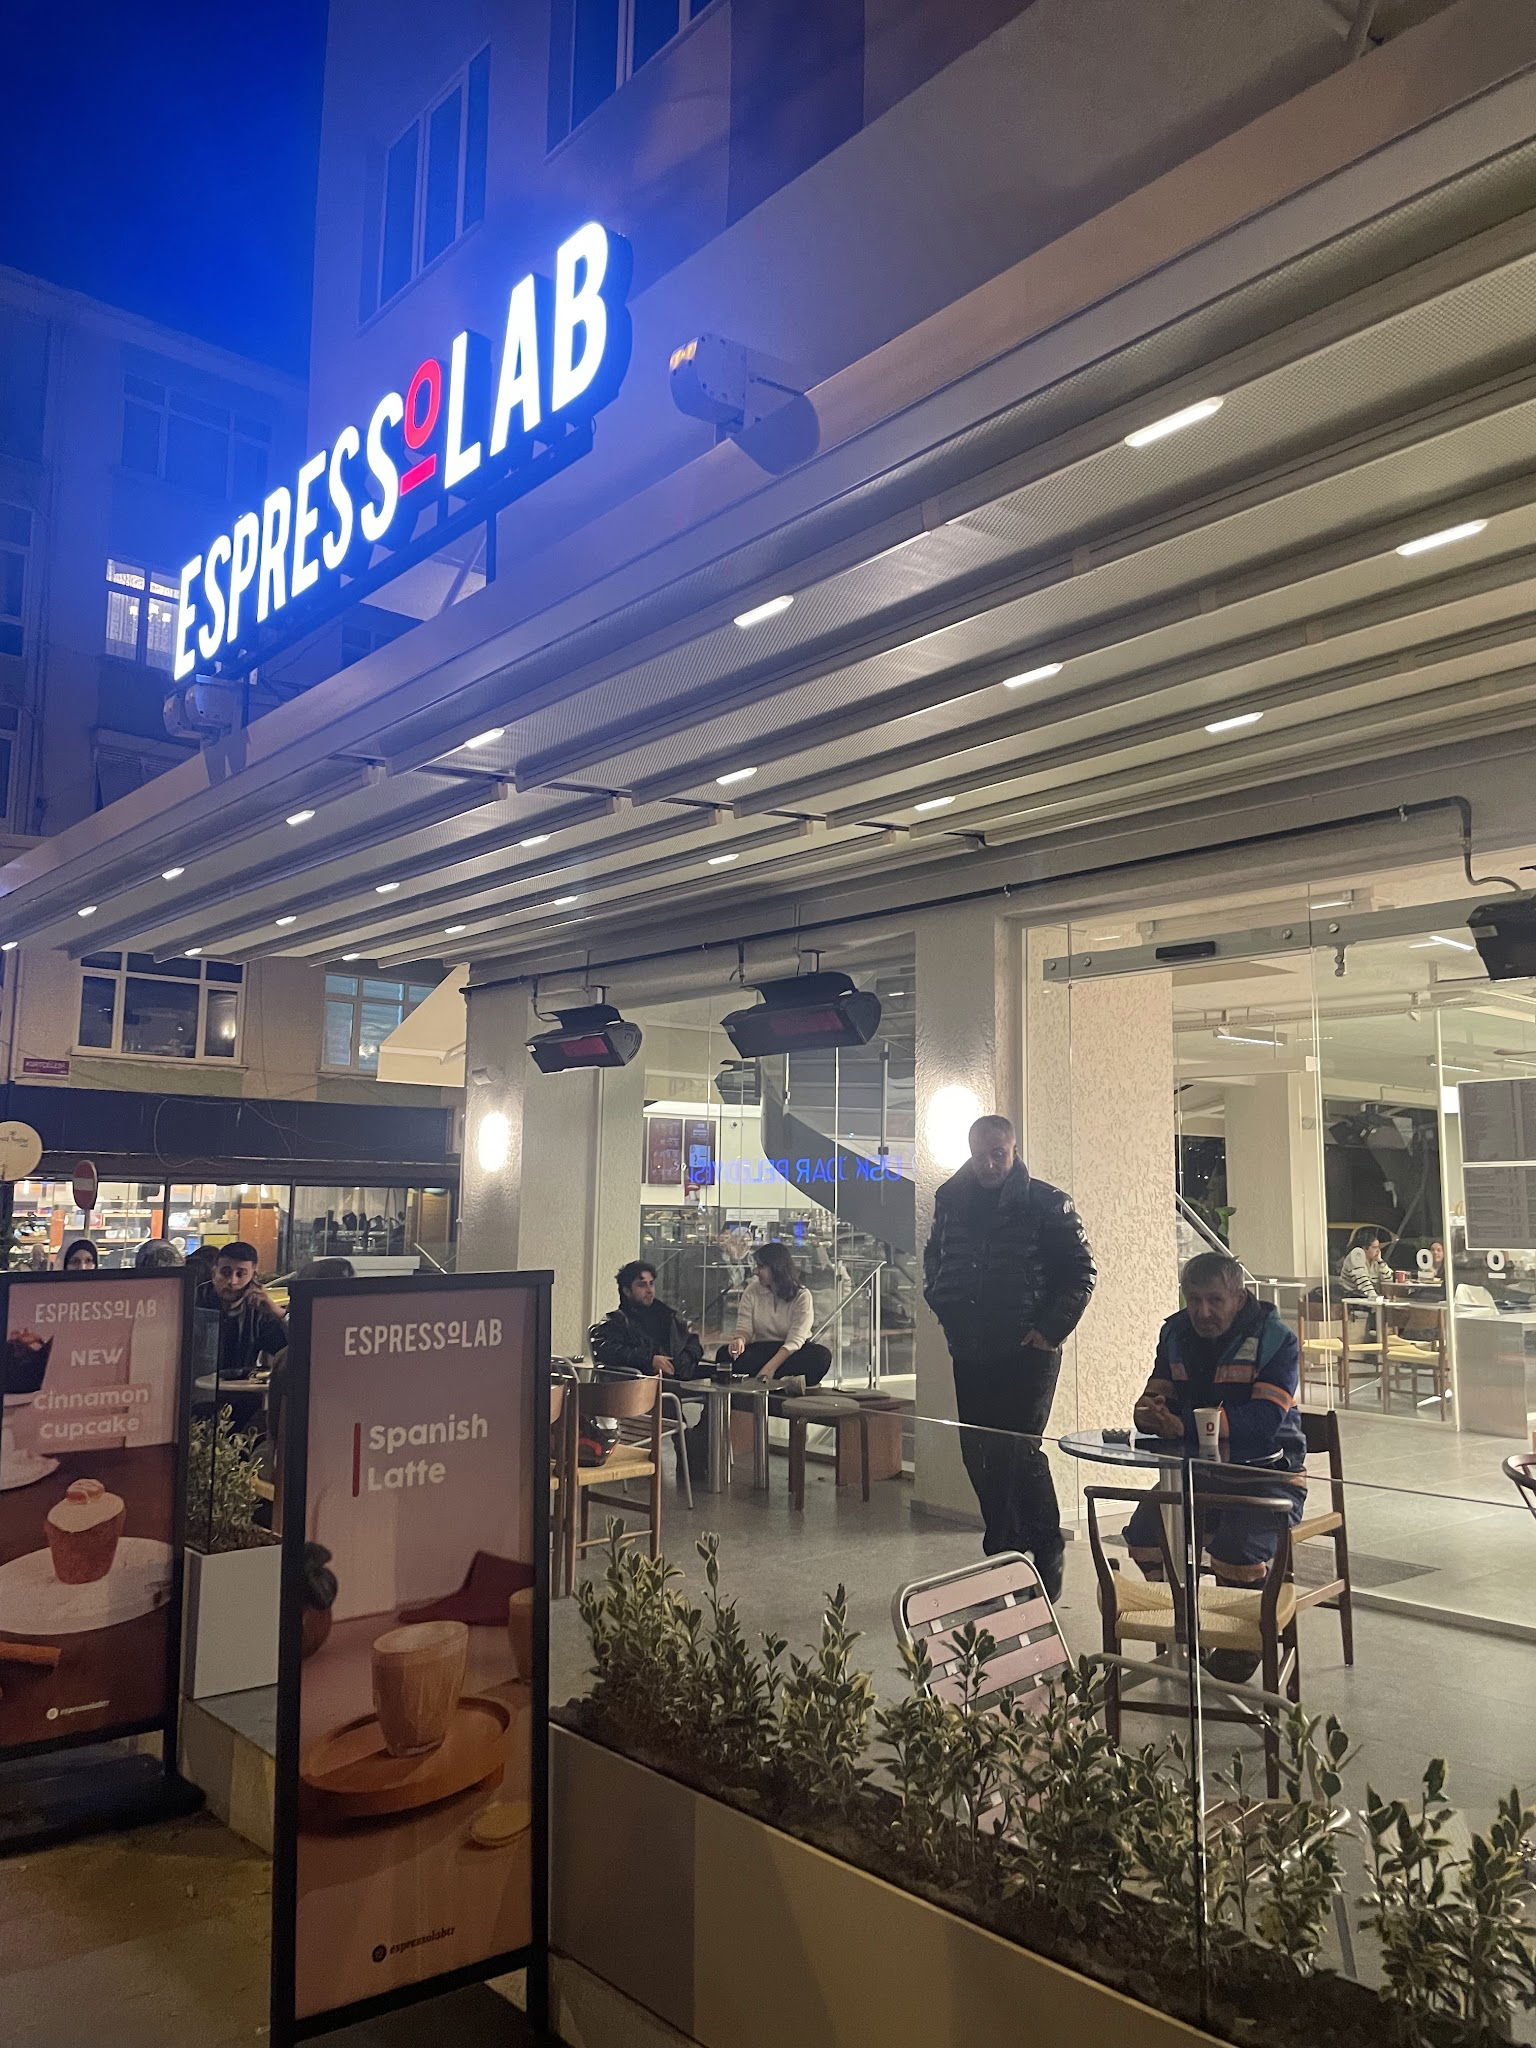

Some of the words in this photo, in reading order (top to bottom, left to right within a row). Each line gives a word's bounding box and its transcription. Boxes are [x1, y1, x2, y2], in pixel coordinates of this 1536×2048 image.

[173, 221, 609, 682] ESPRESSOLAB
[35, 1299, 157, 1323] ESPRESSOLAB
[344, 1318, 503, 1356] ESPRESSOLAB
[70, 1348, 123, 1366] NEW
[368, 1413, 488, 1454] Spanish
[366, 1459, 447, 1491] Latte
